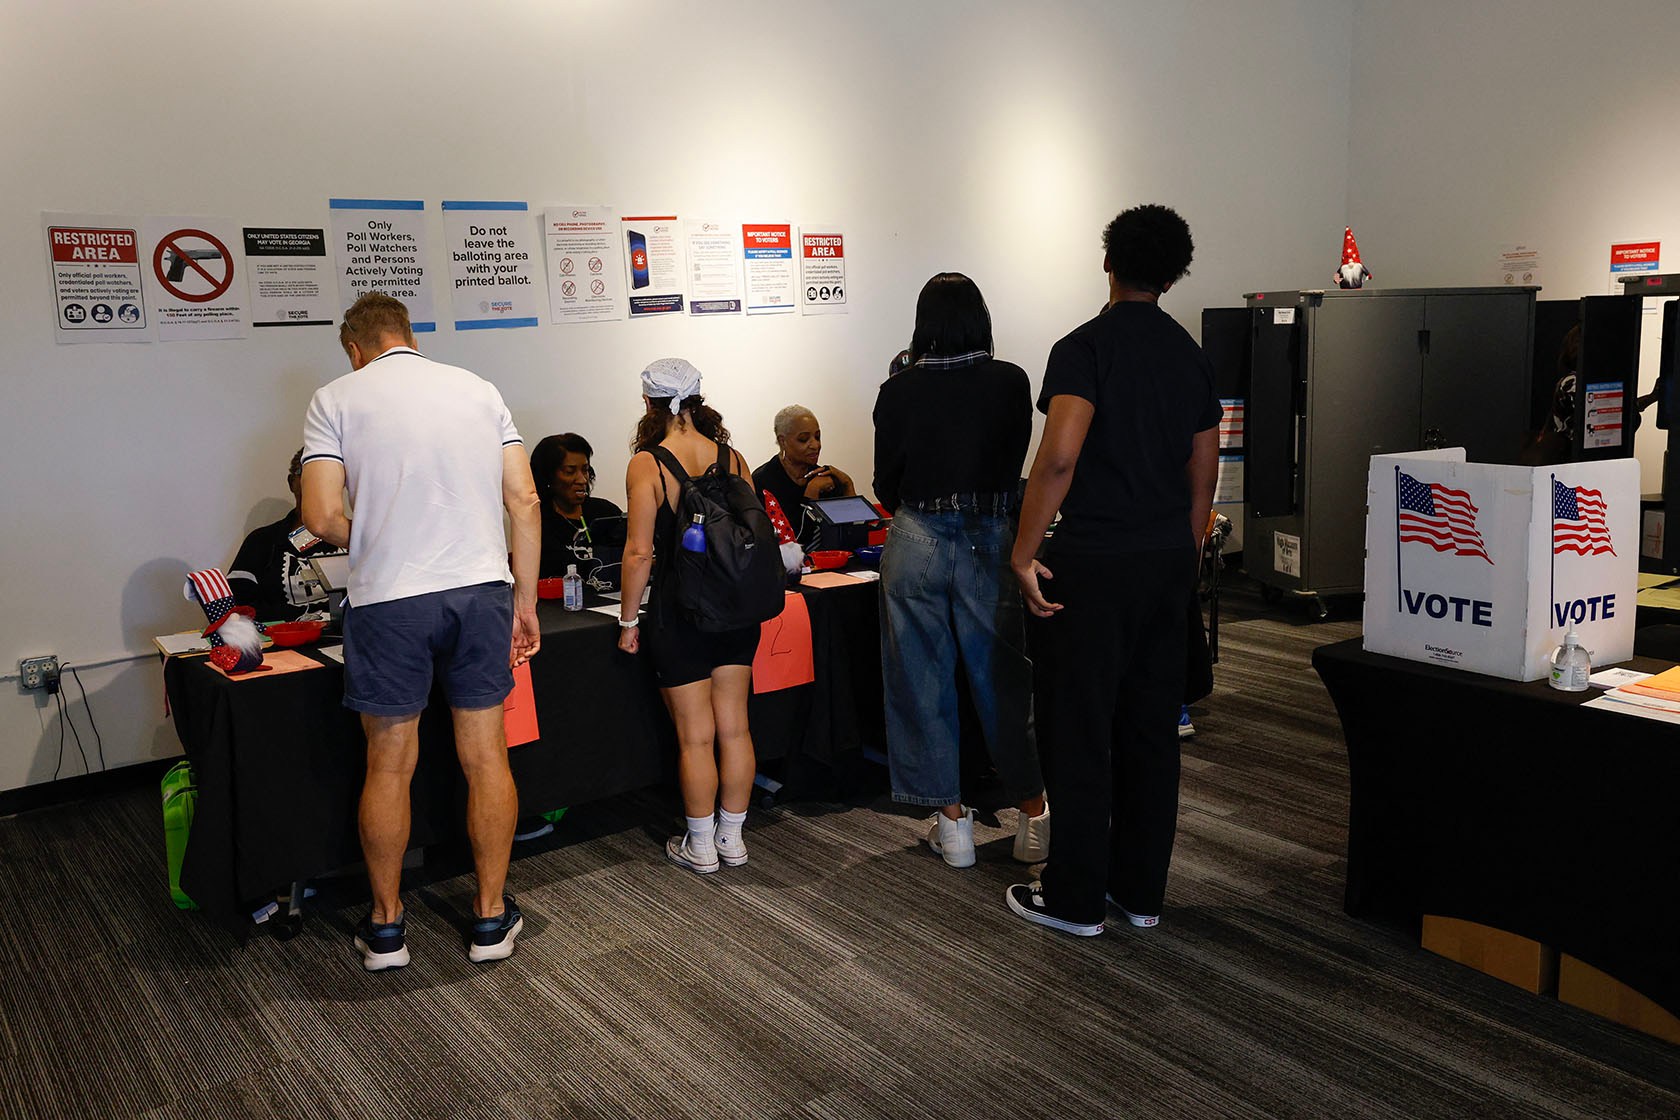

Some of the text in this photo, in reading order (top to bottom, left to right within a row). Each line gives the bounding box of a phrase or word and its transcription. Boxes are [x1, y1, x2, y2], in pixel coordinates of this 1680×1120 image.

[368, 221, 392, 231] Only
[470, 226, 507, 235] Do not
[54, 232, 133, 246] RESTRICTED
[347, 232, 415, 242] Poll Workers,
[804, 237, 842, 246] RESTRICTED
[347, 244, 418, 252] Poll Watchers
[464, 238, 514, 248] leave the
[72, 247, 120, 260] AREA
[812, 247, 835, 256] AREA
[453, 251, 501, 263] balloting
[346, 266, 423, 277] Actively Voting
[466, 264, 518, 275] with your
[371, 278, 420, 288] permitted
[455, 275, 531, 288] printed ballot.
[1403, 590, 1492, 627] VOTE
[1555, 594, 1616, 627] VOTE
